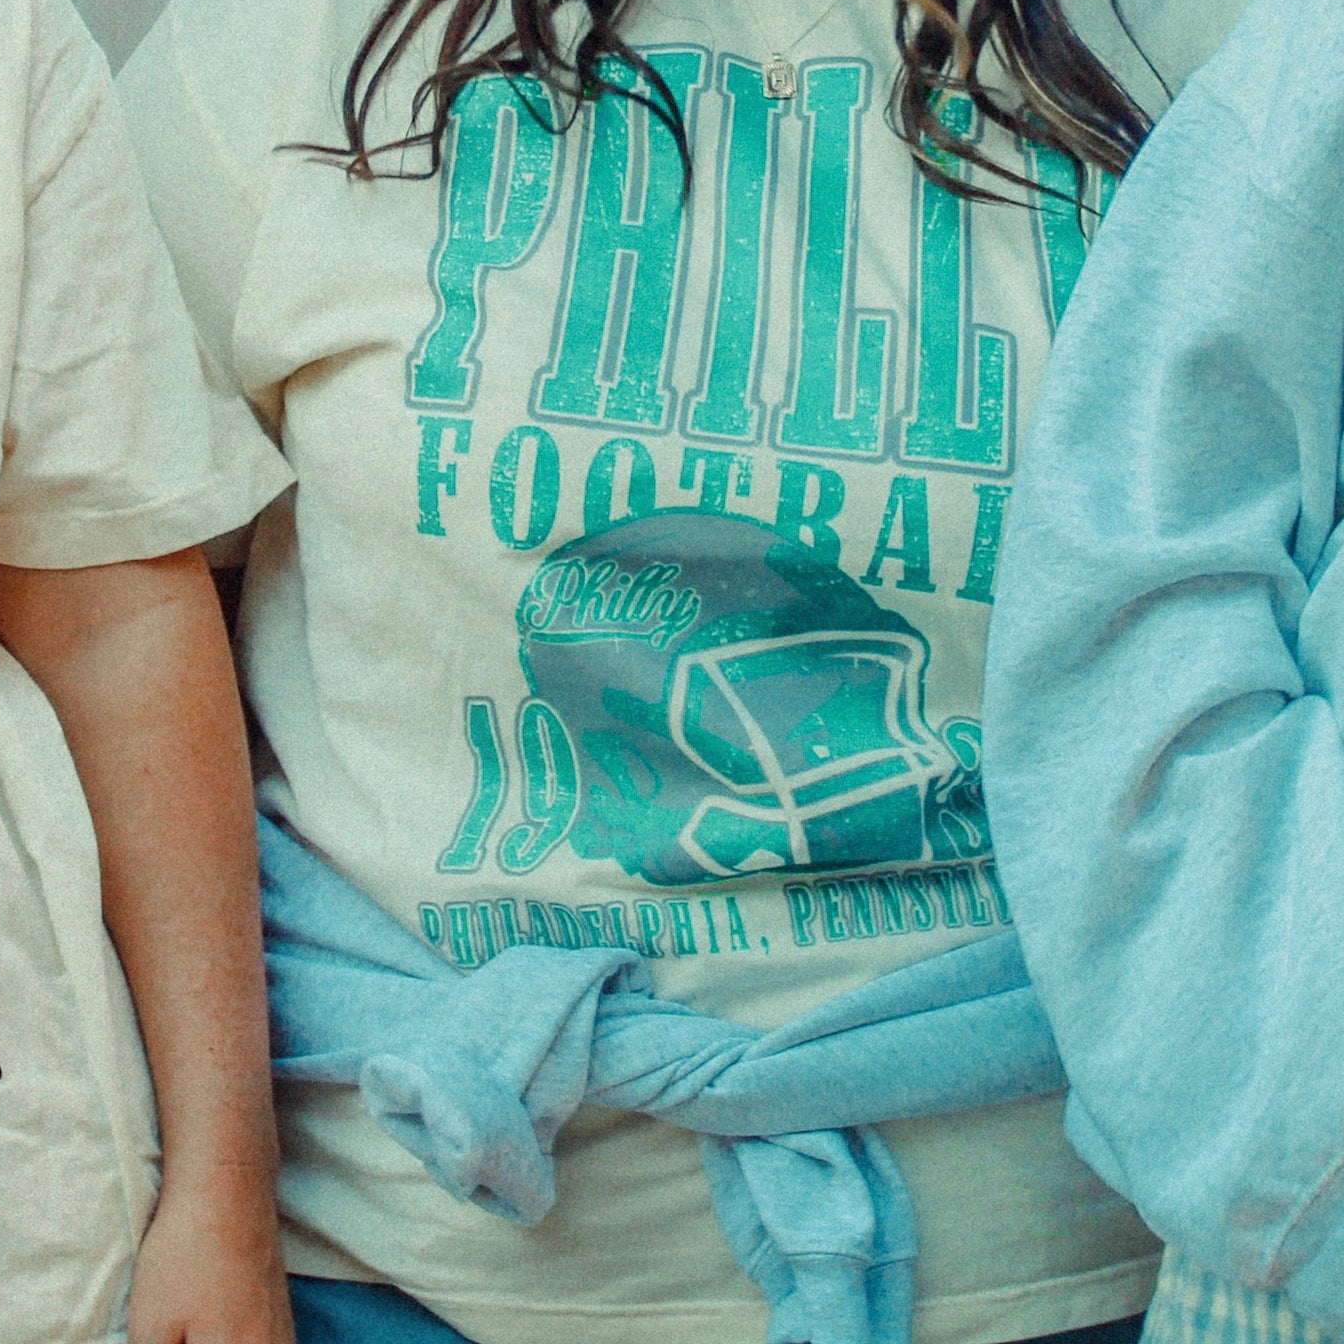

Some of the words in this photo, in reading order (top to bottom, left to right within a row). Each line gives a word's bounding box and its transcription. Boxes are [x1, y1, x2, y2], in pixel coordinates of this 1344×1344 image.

[416, 415, 1012, 606] FOOTBAL
[524, 557, 701, 650] Philly
[435, 696, 581, 876] 19
